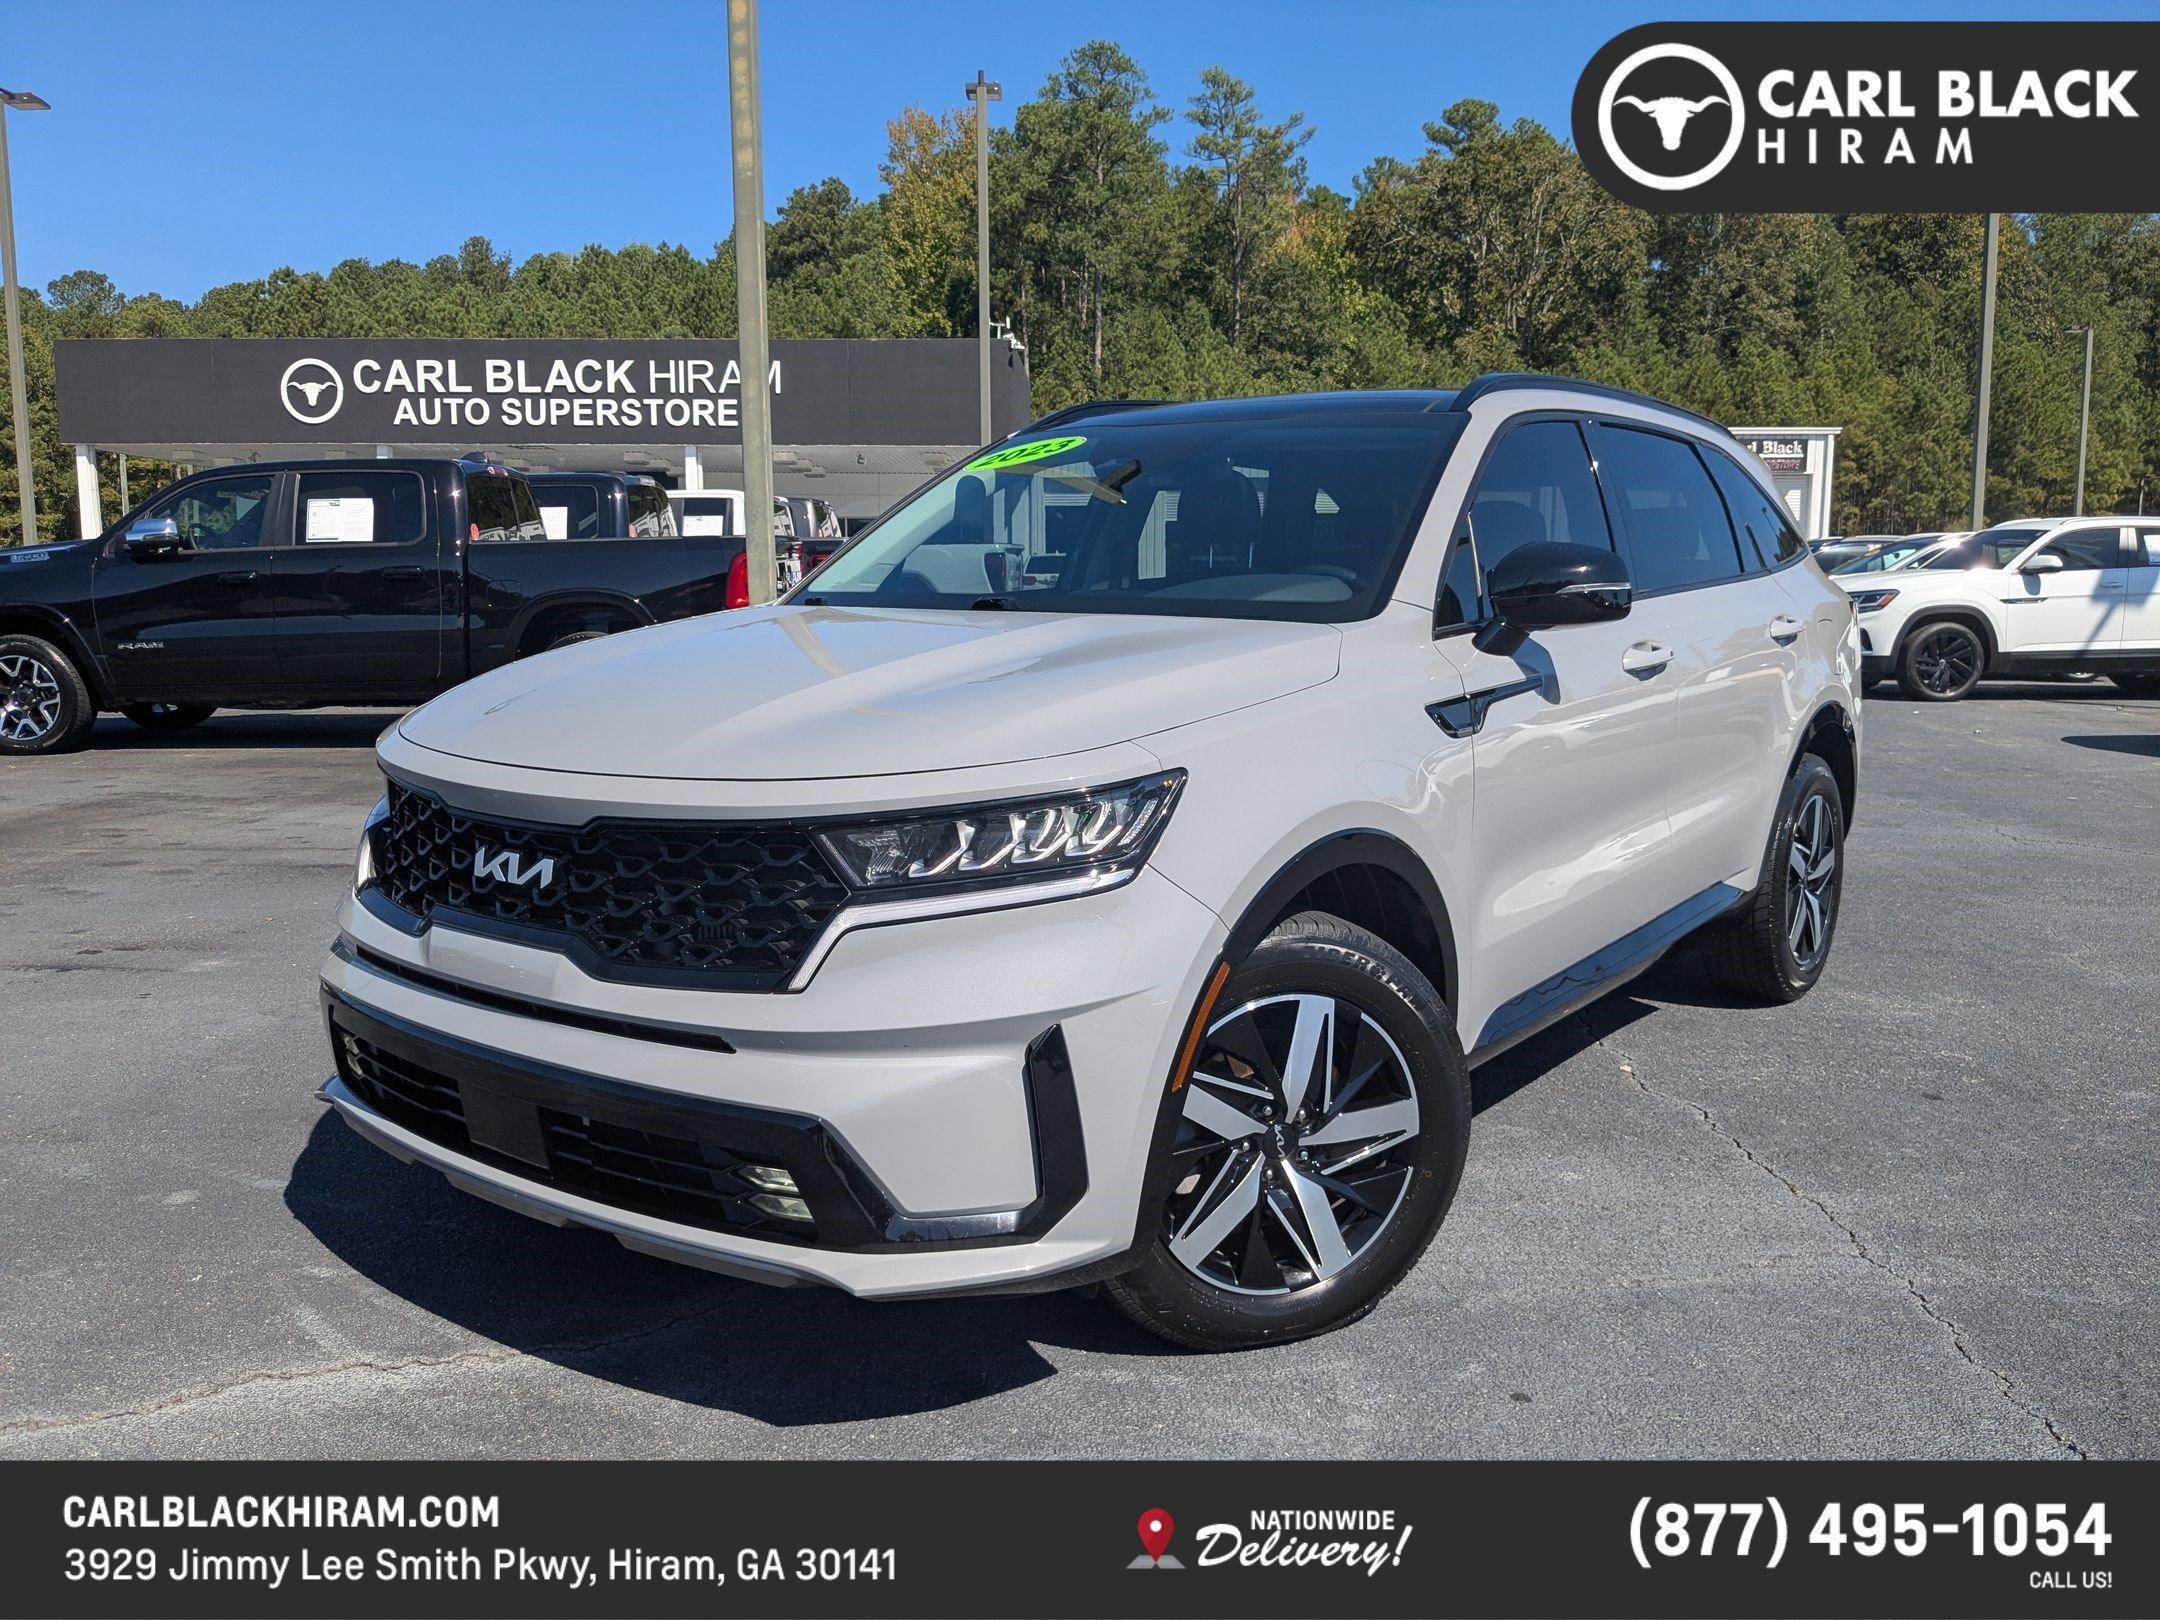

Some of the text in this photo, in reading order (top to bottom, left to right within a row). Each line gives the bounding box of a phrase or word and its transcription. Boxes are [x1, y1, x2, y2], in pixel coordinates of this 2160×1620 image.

[352, 359, 473, 394] CARL
[485, 359, 637, 394] BLACK
[393, 397, 739, 427] AUTO SUPERSTORE
[972, 439, 1077, 469] 2023
[1762, 440, 1803, 455] Black
[473, 847, 554, 889] KIA
